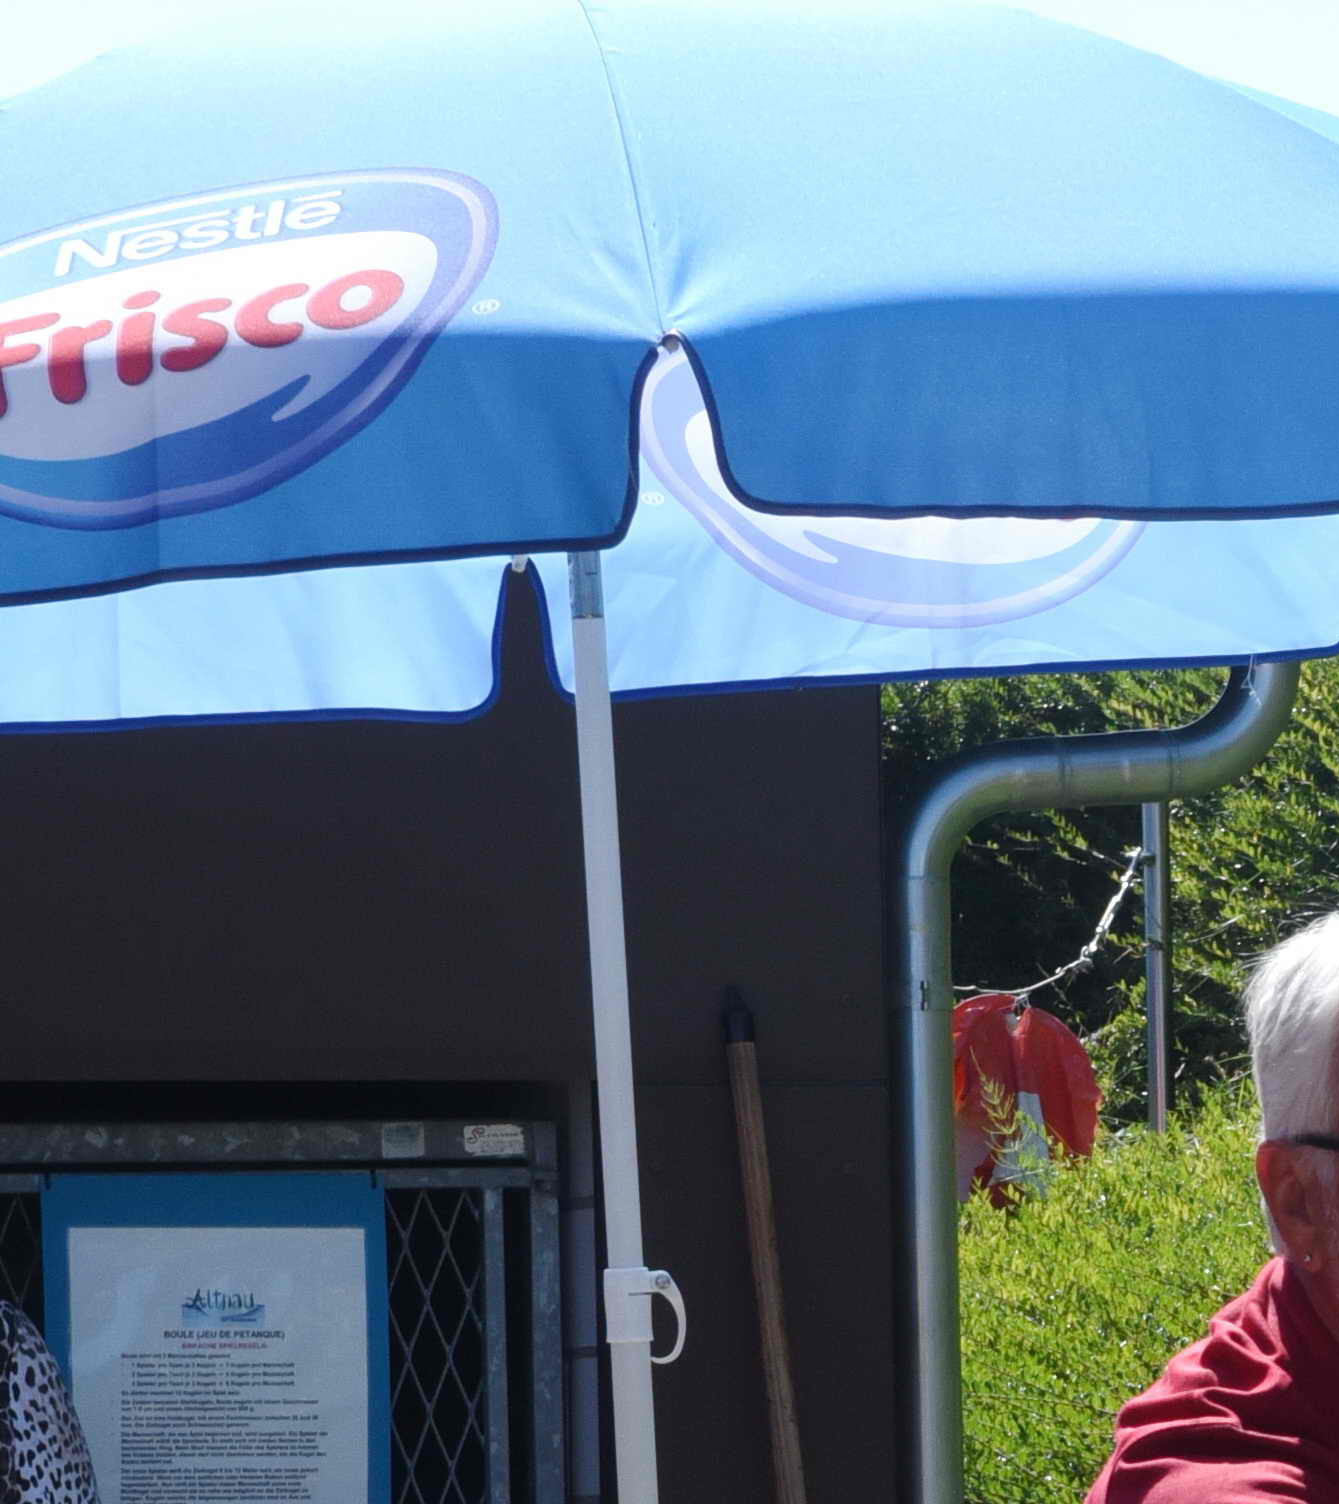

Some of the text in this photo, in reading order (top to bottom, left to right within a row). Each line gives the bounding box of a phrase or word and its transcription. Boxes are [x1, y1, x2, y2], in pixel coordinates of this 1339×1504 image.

[53, 190, 345, 277] Nestlé
[0, 268, 405, 420] Frisco
[163, 1330, 194, 1339] BOULE
[219, 1330, 231, 1339] DE
